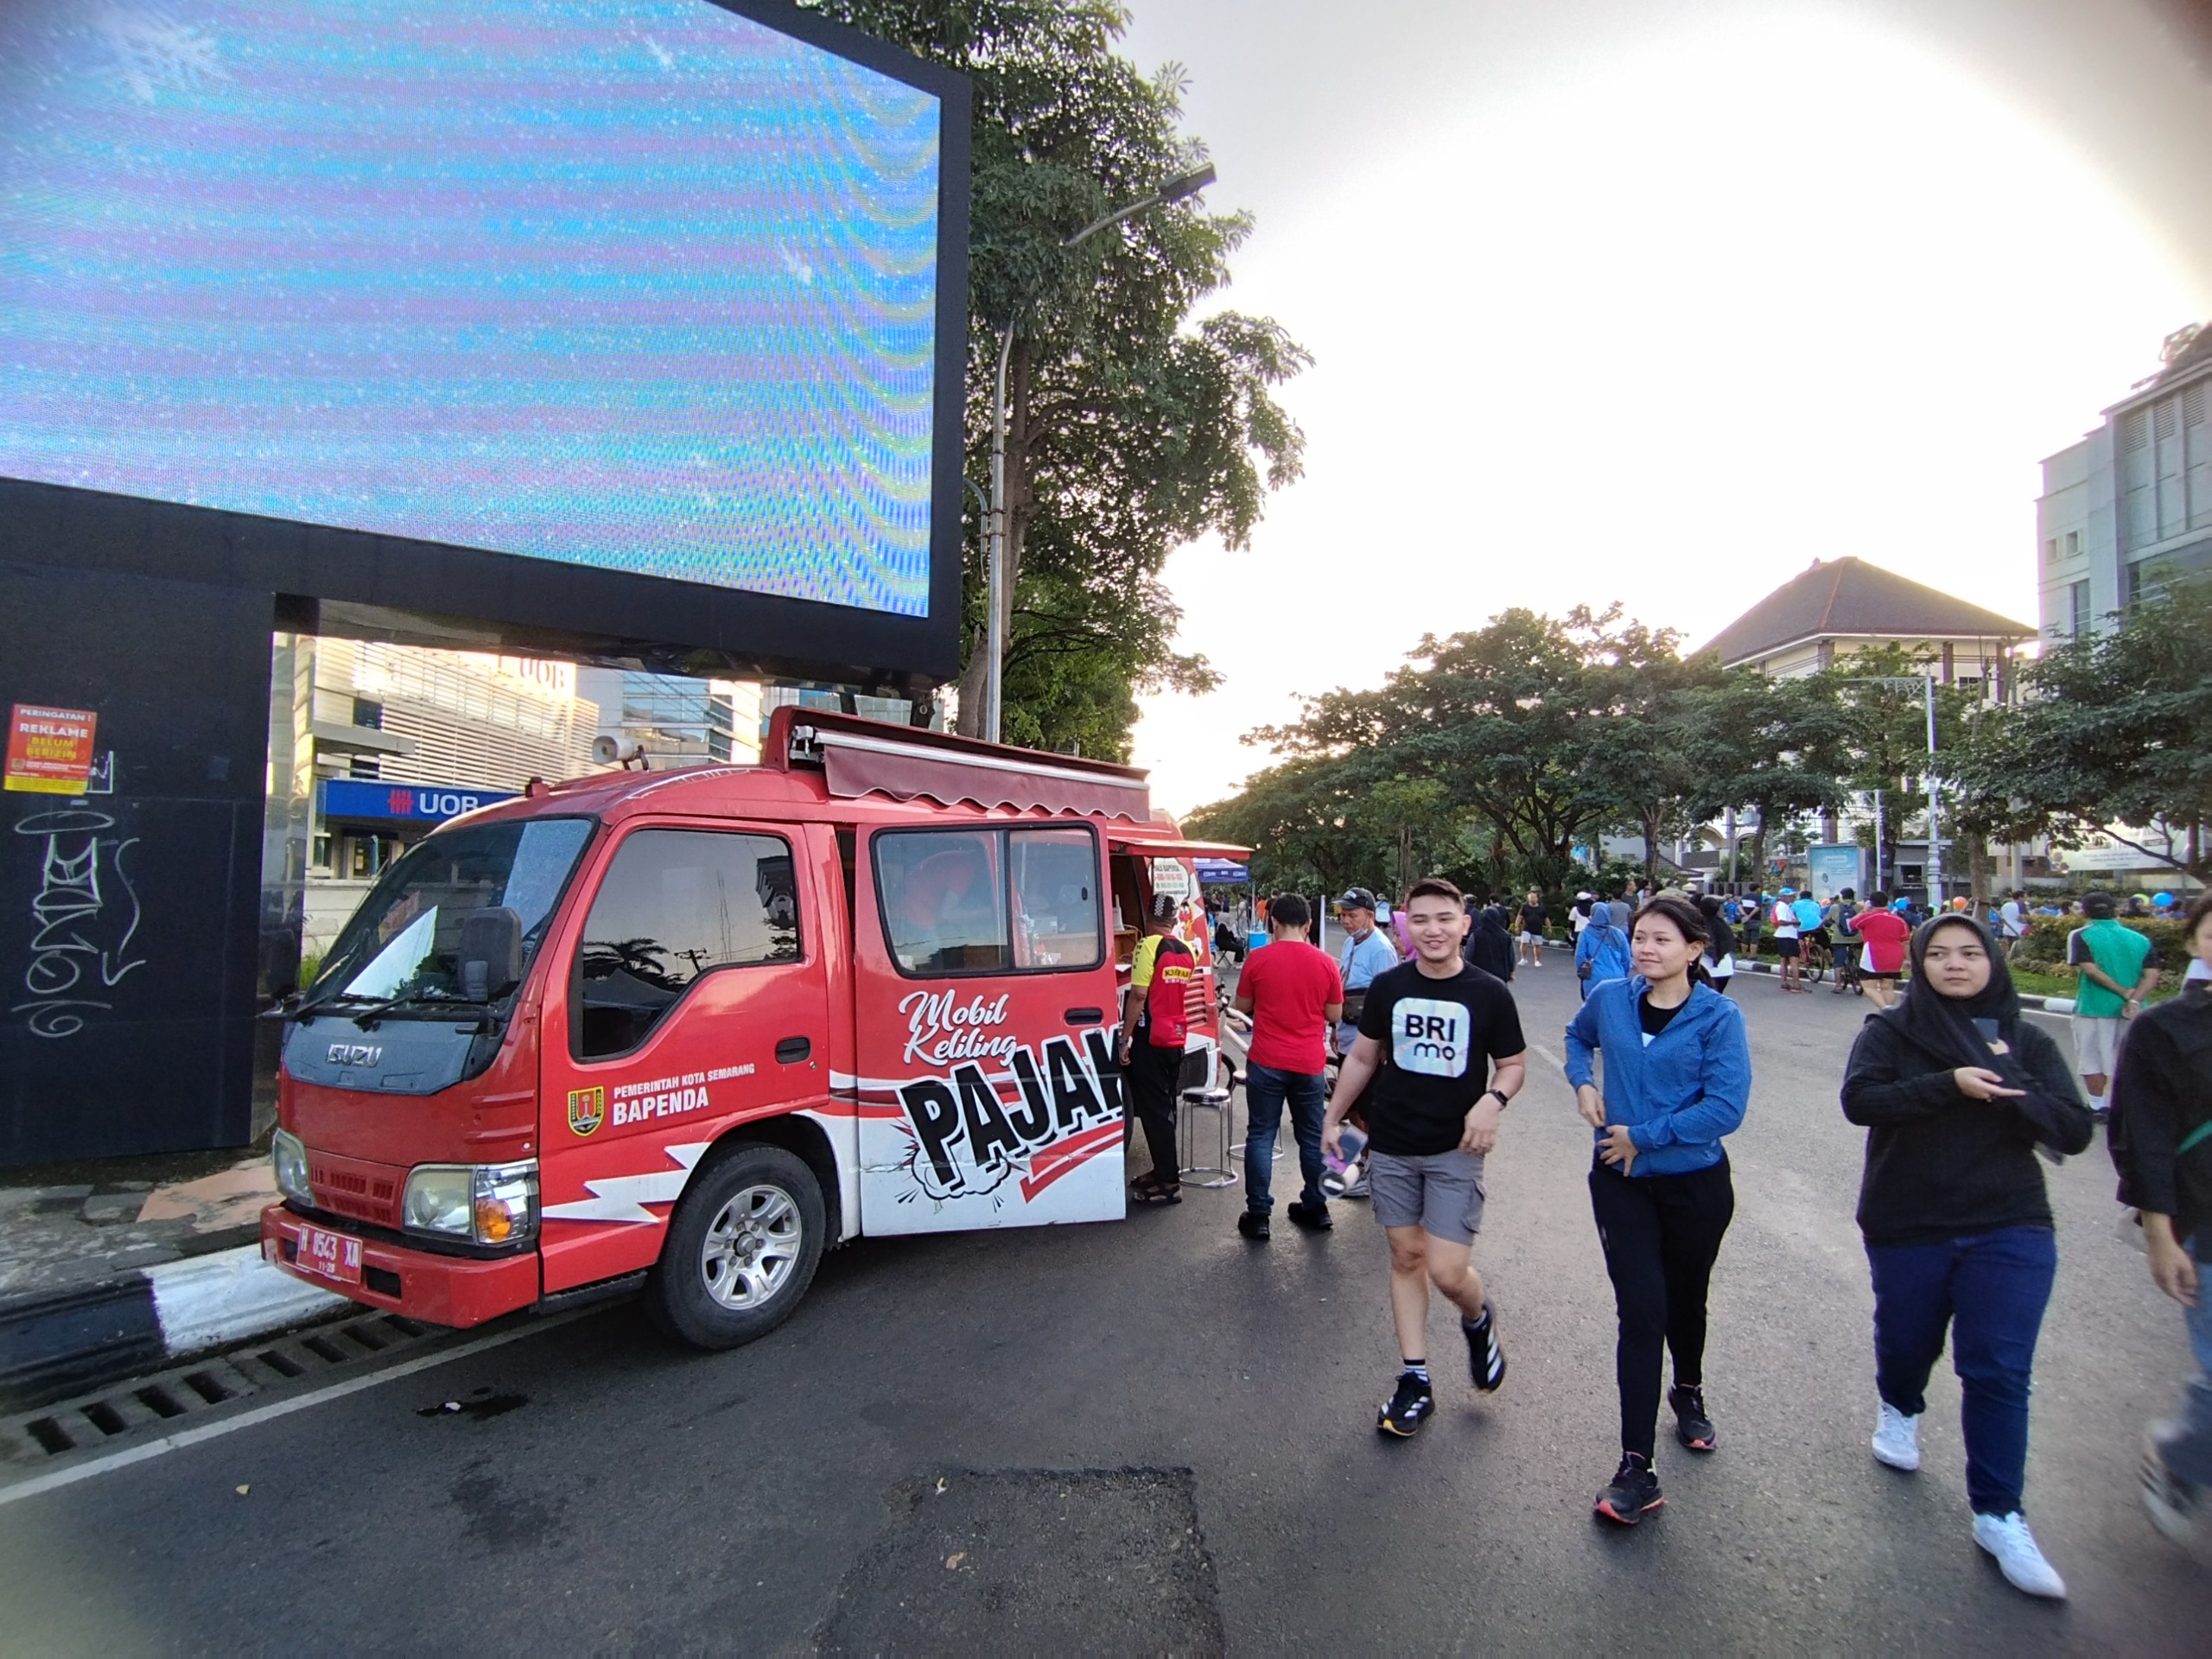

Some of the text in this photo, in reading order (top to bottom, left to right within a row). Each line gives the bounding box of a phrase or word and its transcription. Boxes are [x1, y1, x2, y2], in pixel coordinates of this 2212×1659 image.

[19, 709, 85, 721] PERINGATAN
[19, 722, 89, 738] REKLAME
[26, 747, 77, 760] BERIZIN
[31, 736, 74, 749] BELUM
[419, 791, 479, 815] UOB
[898, 988, 1010, 1034] Mobil
[1405, 1014, 1456, 1043] BRI
[326, 1044, 382, 1068] ISUZU
[903, 1023, 1018, 1067] Keliling
[1414, 1042, 1456, 1061] mo
[613, 1063, 756, 1099] PEMERINTAH KOTA SEMARANG
[613, 1086, 709, 1126] BAPENDA
[299, 1227, 309, 1252] H
[344, 1240, 359, 1268] XA
